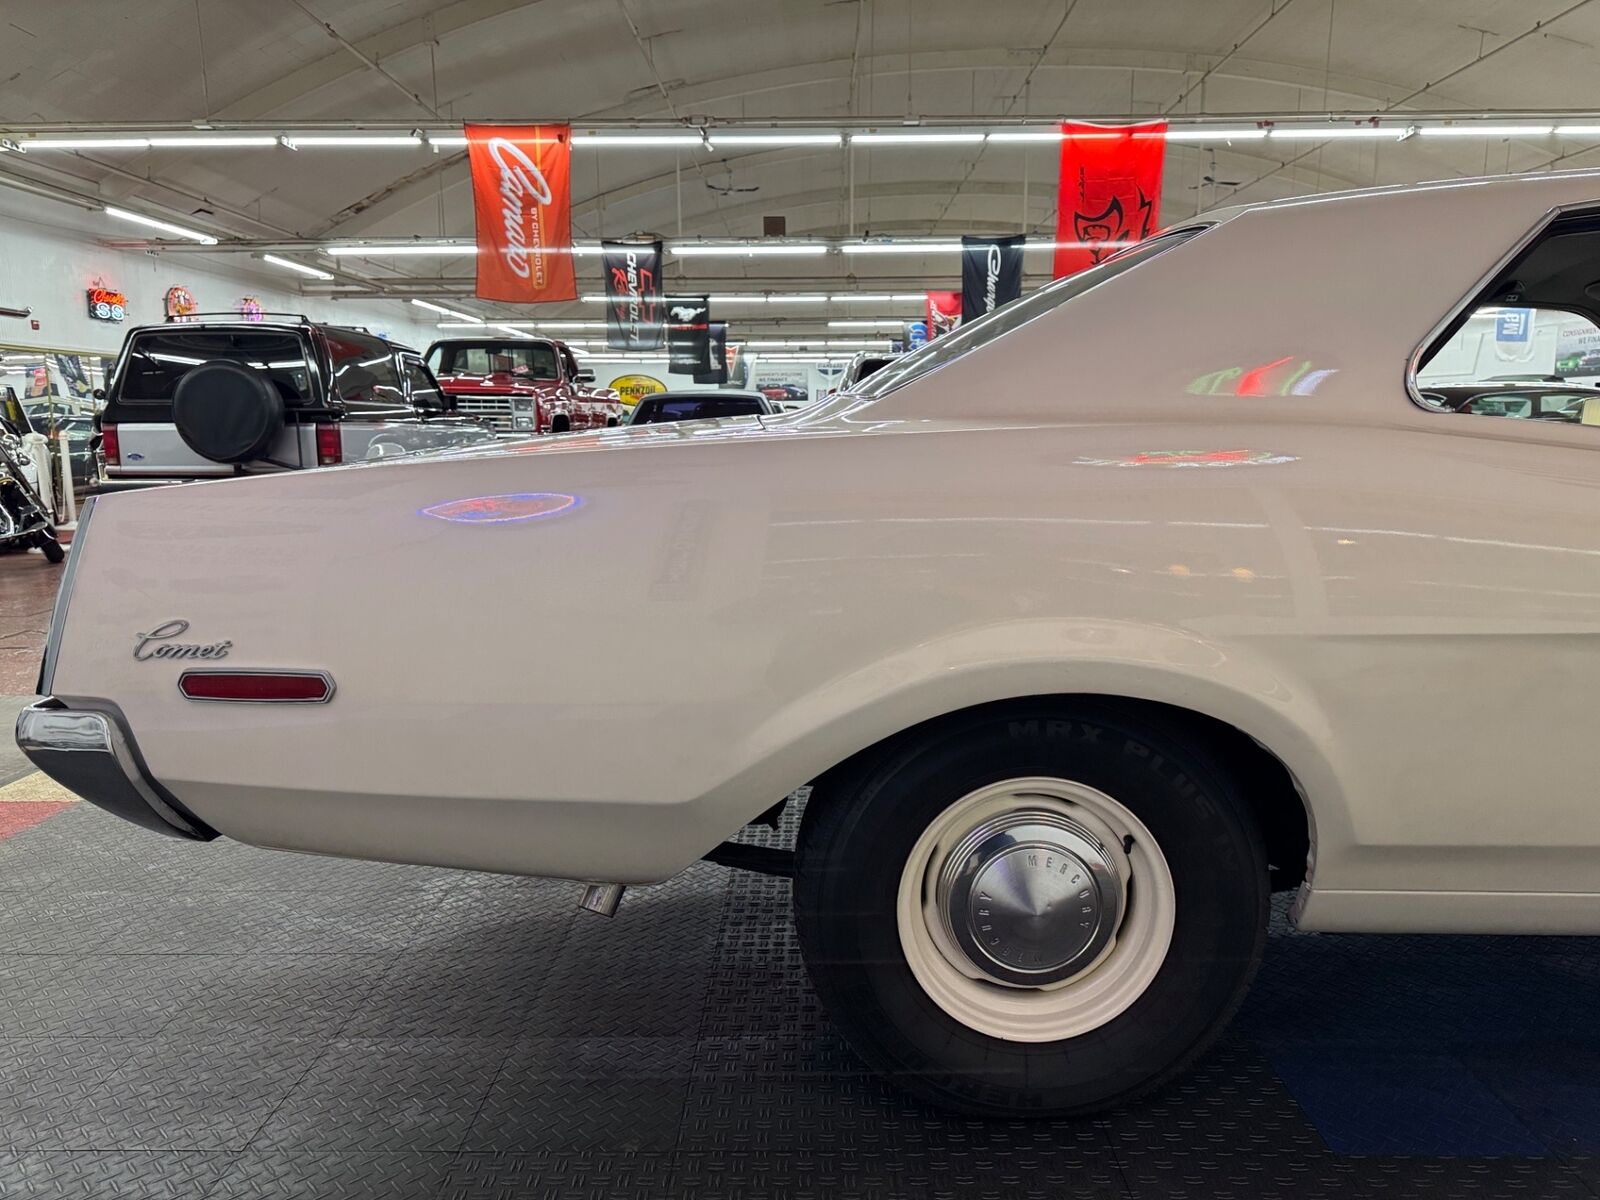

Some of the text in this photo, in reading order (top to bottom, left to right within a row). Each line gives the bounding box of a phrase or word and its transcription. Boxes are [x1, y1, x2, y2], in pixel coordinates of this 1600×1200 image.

[488, 137, 552, 279] Camaro
[530, 207, 543, 285] BY CHEVROLET
[95, 303, 124, 320] SS
[626, 251, 640, 343] CHEVROLET
[133, 619, 233, 661] Comet
[1008, 719, 1104, 741] MRX
[978, 890, 1044, 964] MERCURY
[1027, 854, 1093, 930] MERCURY
